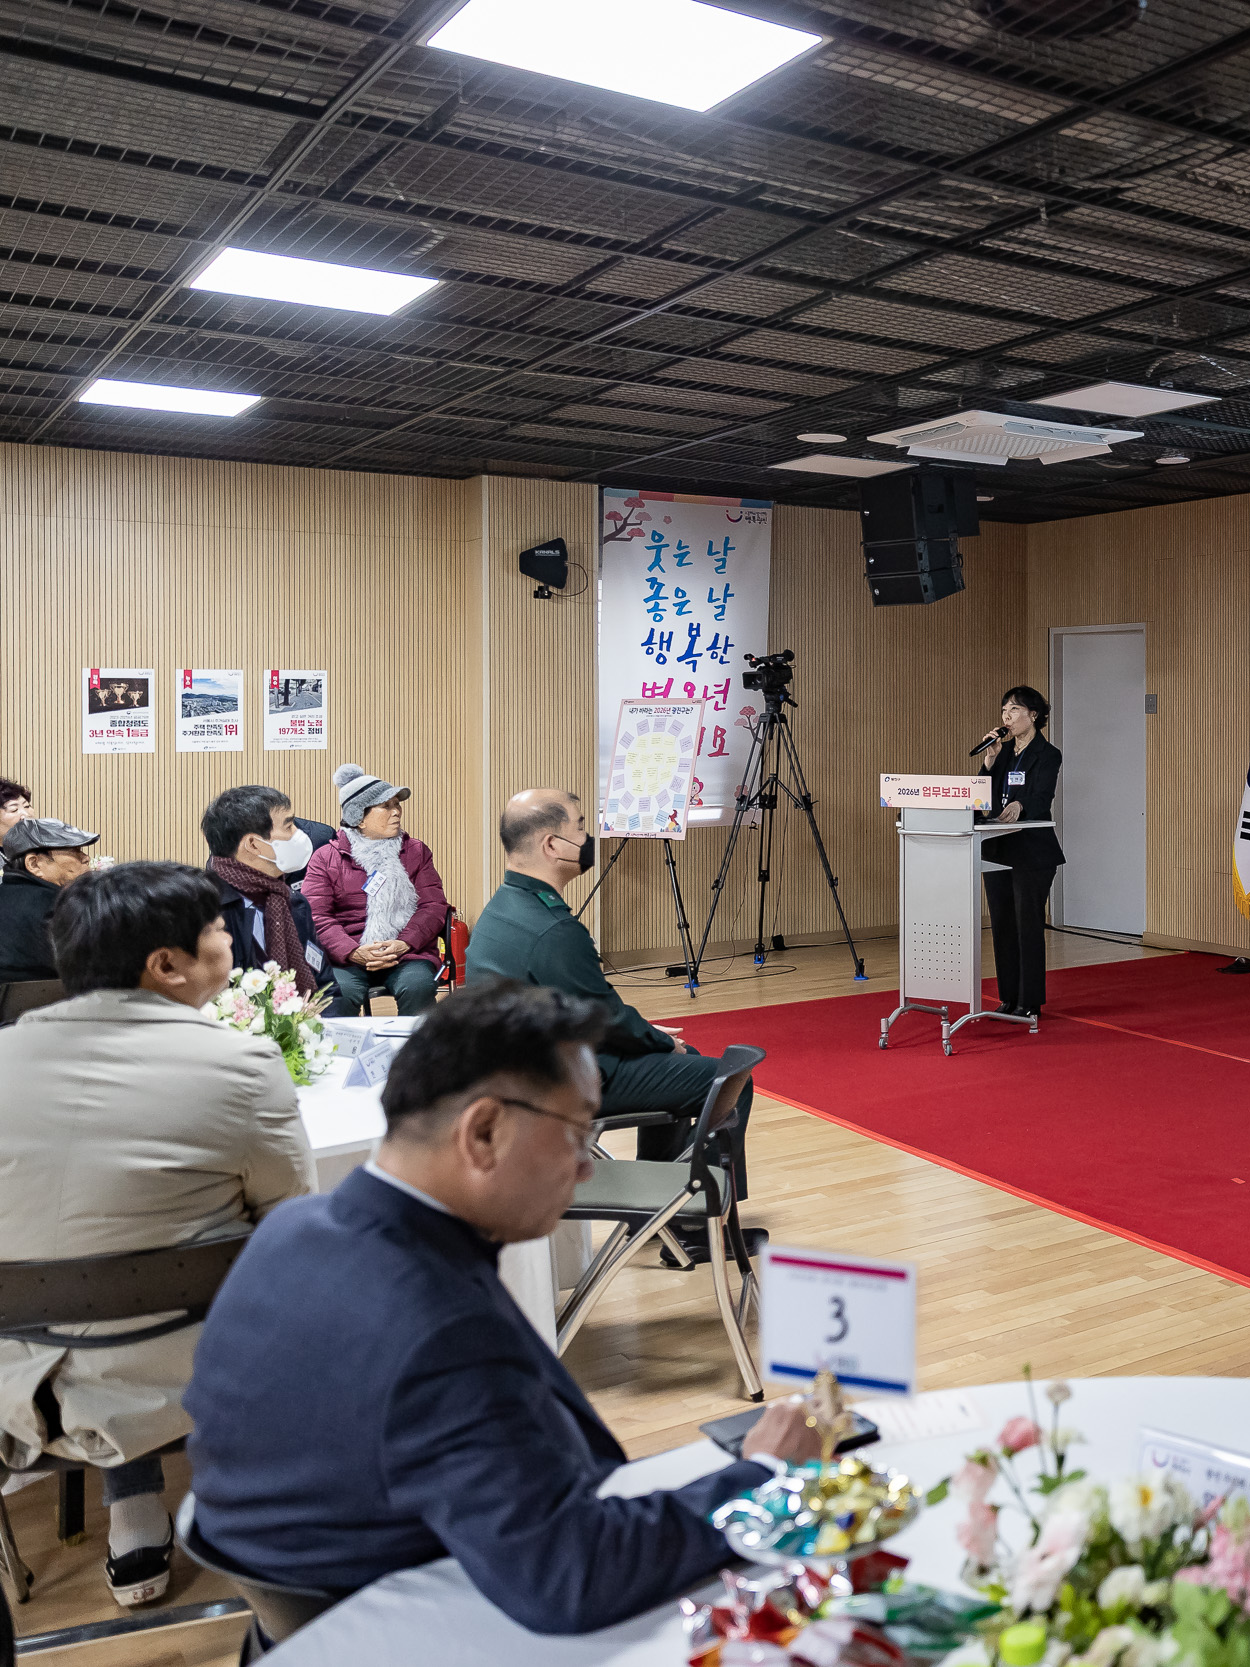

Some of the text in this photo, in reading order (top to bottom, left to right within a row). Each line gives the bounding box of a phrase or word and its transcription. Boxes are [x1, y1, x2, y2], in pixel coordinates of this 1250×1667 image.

[645, 529, 735, 574] 웃는 날
[643, 577, 735, 622] 좋은 날
[640, 622, 735, 673] 행복한
[89, 727, 149, 738] 3년 연속 1등급
[224, 724, 238, 736] 1위
[278, 727, 305, 735] 197개소
[897, 786, 971, 799] 2026년 업무보고회
[825, 1296, 849, 1343] 3
